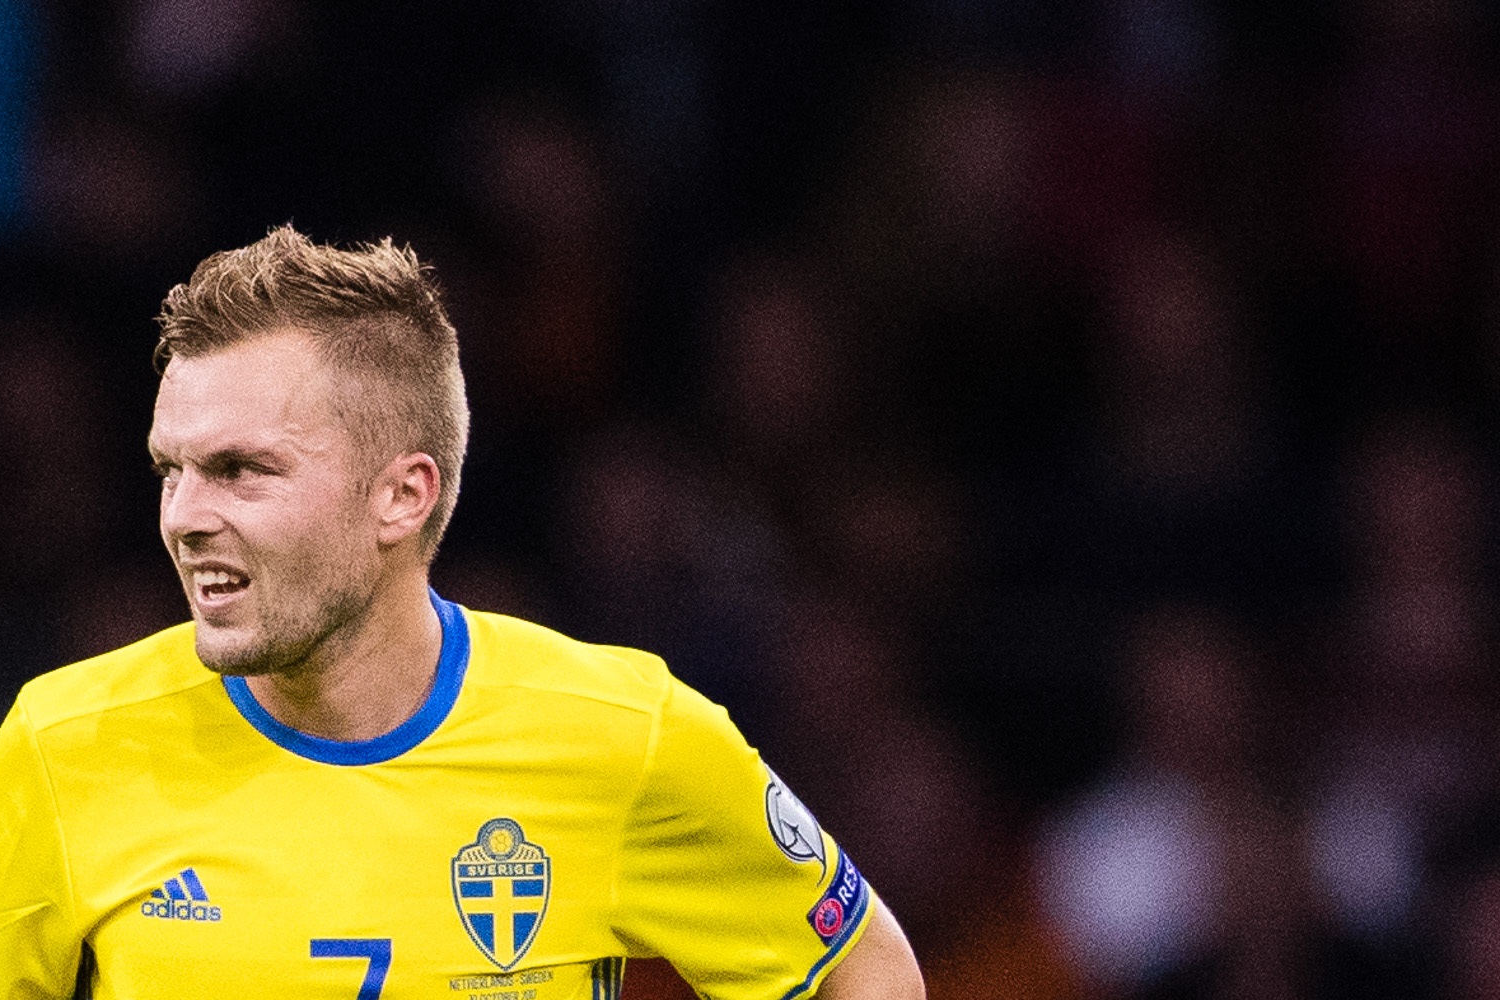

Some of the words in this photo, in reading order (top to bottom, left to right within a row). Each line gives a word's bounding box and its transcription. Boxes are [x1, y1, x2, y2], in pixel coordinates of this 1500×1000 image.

[467, 863, 534, 876] SVERIGE
[838, 853, 858, 905] RES
[141, 900, 221, 921] adidas
[449, 974, 513, 991] NETHERLANDS
[520, 970, 554, 985] SWEDEN
